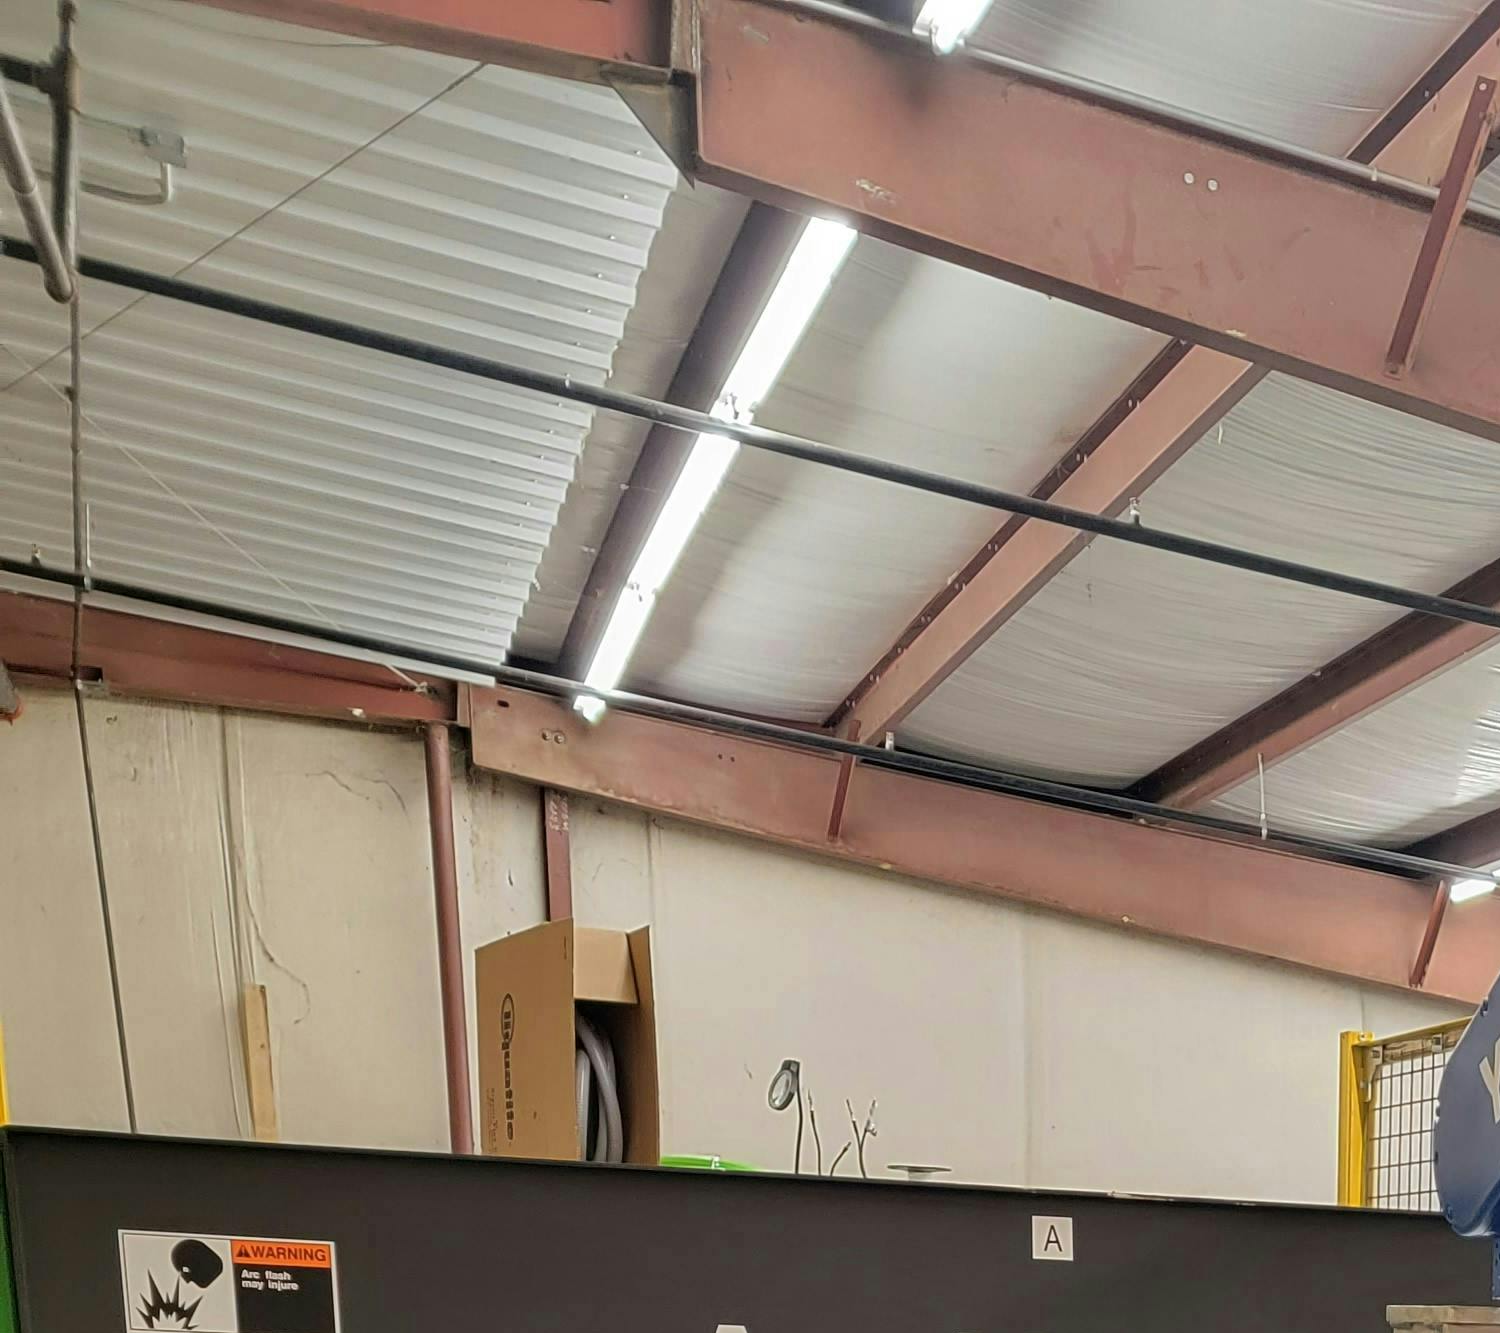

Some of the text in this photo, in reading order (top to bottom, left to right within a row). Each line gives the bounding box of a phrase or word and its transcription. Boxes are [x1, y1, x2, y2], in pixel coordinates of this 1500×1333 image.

[1043, 1224, 1064, 1253] A
[251, 1246, 327, 1262] WARNING
[241, 1269, 292, 1281] Arc flash
[241, 1279, 299, 1292] may injure
